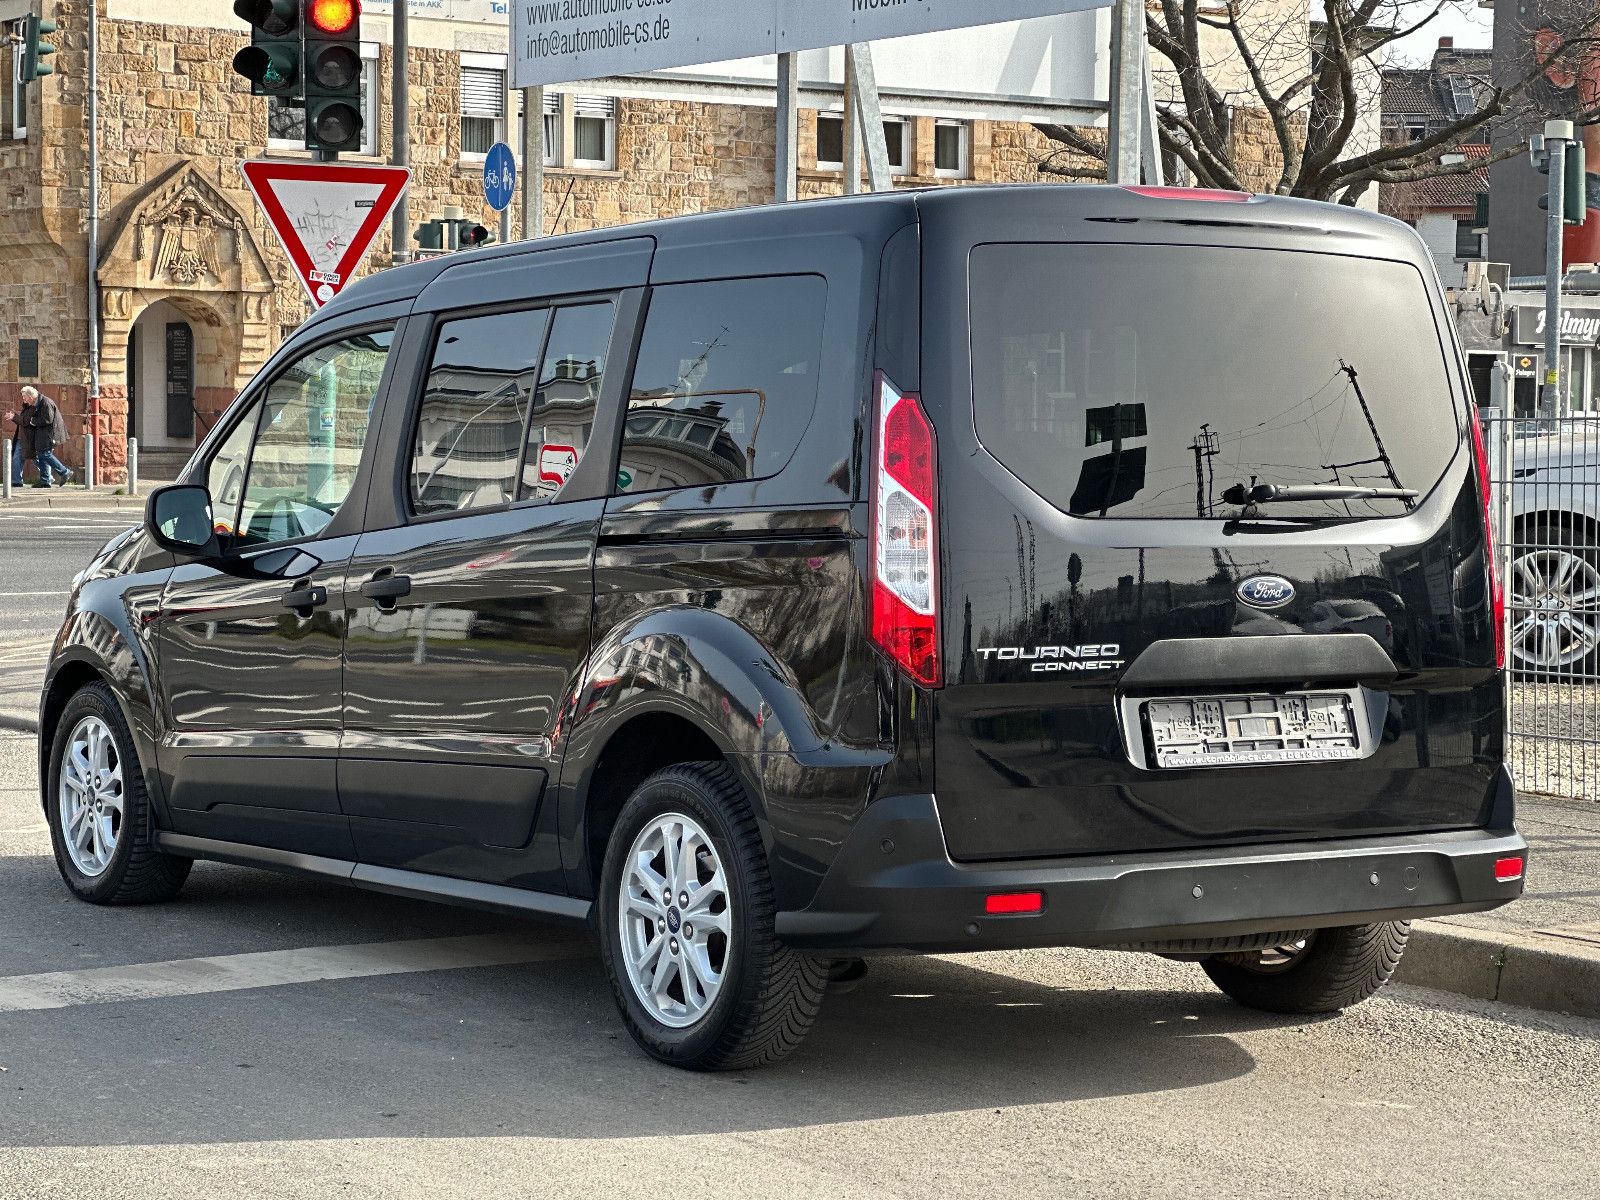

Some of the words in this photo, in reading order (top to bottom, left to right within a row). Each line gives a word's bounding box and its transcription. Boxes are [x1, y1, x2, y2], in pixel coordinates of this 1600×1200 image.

[490, 2, 510, 14] Tel.
[527, 0, 672, 25] www.automo.
[527, 14, 670, 59] info@automobile-cs.de
[1536, 310, 1600, 340] Plmyr
[1254, 581, 1284, 599] Ford
[977, 644, 1120, 660] TOURNEO
[1031, 660, 1125, 672] CONNECT
